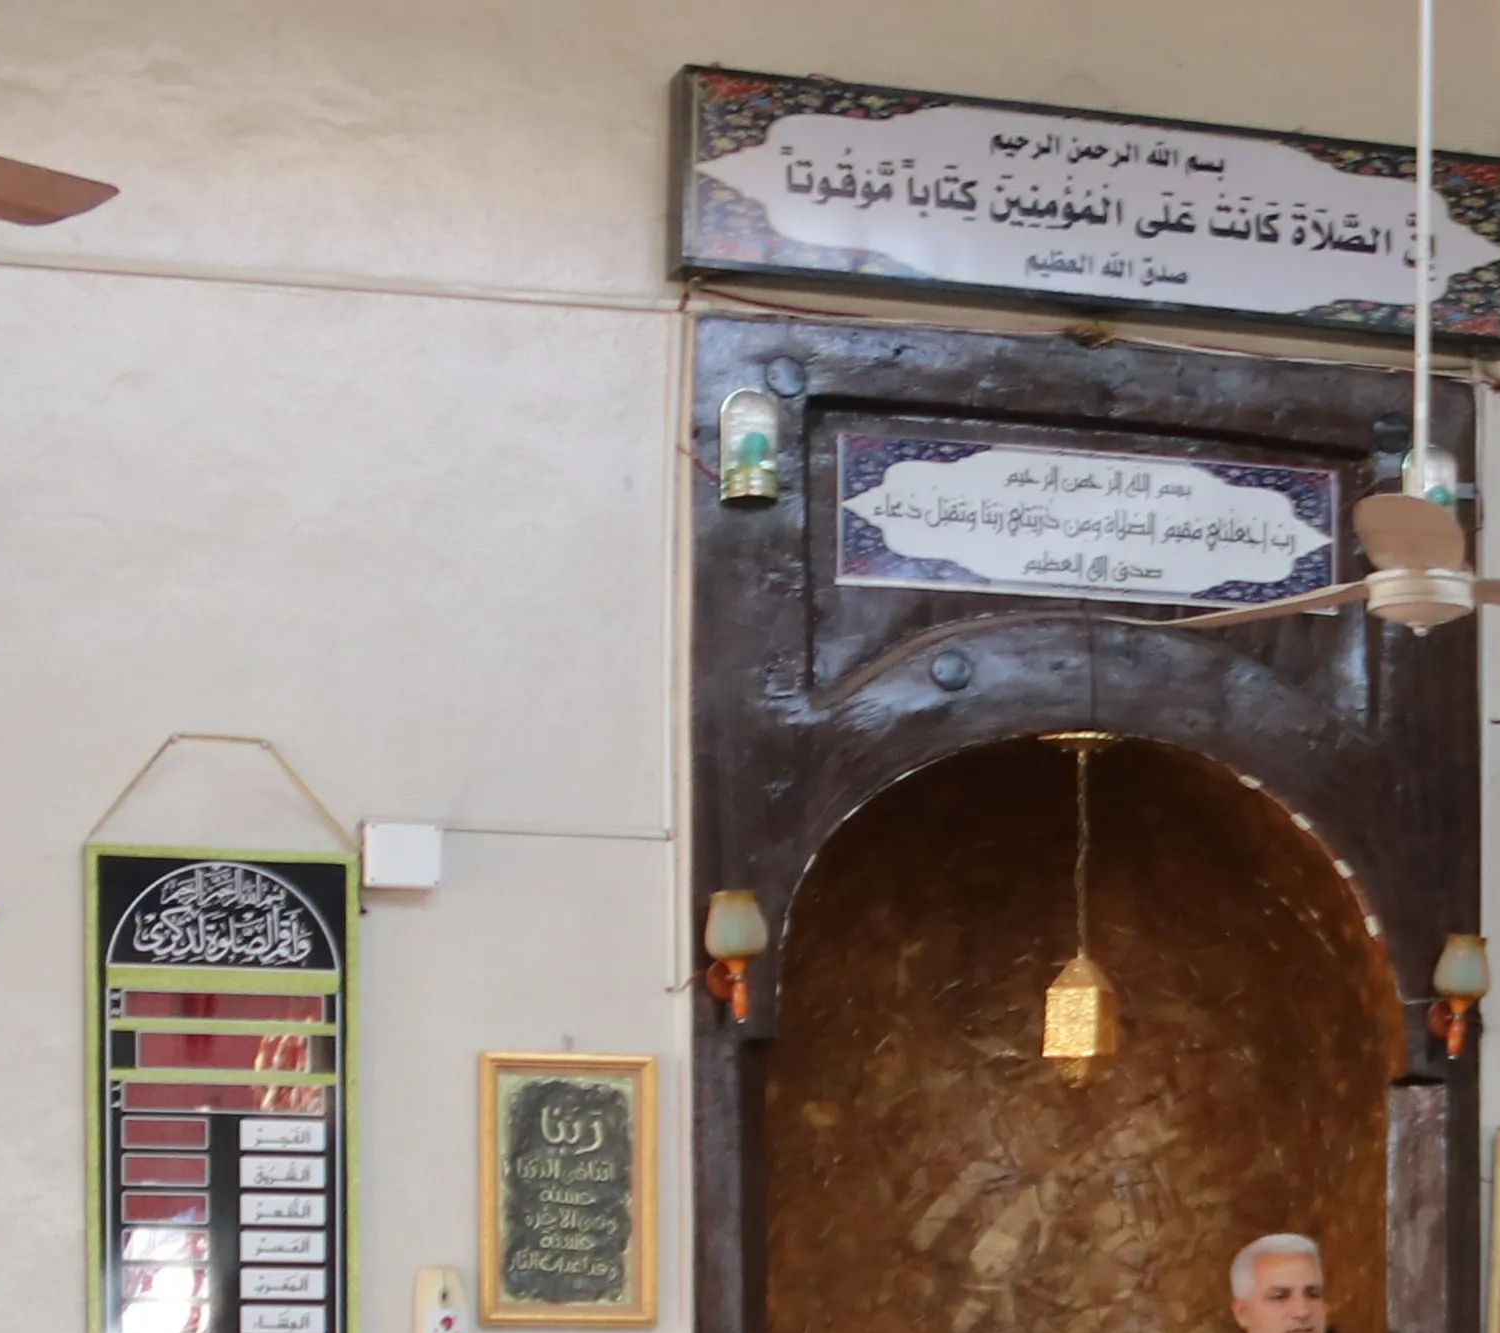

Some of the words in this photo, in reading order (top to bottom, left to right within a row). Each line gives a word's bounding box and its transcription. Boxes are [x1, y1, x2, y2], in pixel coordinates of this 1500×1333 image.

[990, 132, 1061, 158] الرحيم
[1067, 136, 1138, 171] الرحمن
[1147, 140, 1178, 167] الله
[1185, 157, 1225, 182] بسم
[1025, 249, 1094, 278] العظيم
[1101, 251, 1133, 279] الله
[1140, 256, 1189, 287] صدق
[1155, 483, 1192, 500] بسم
